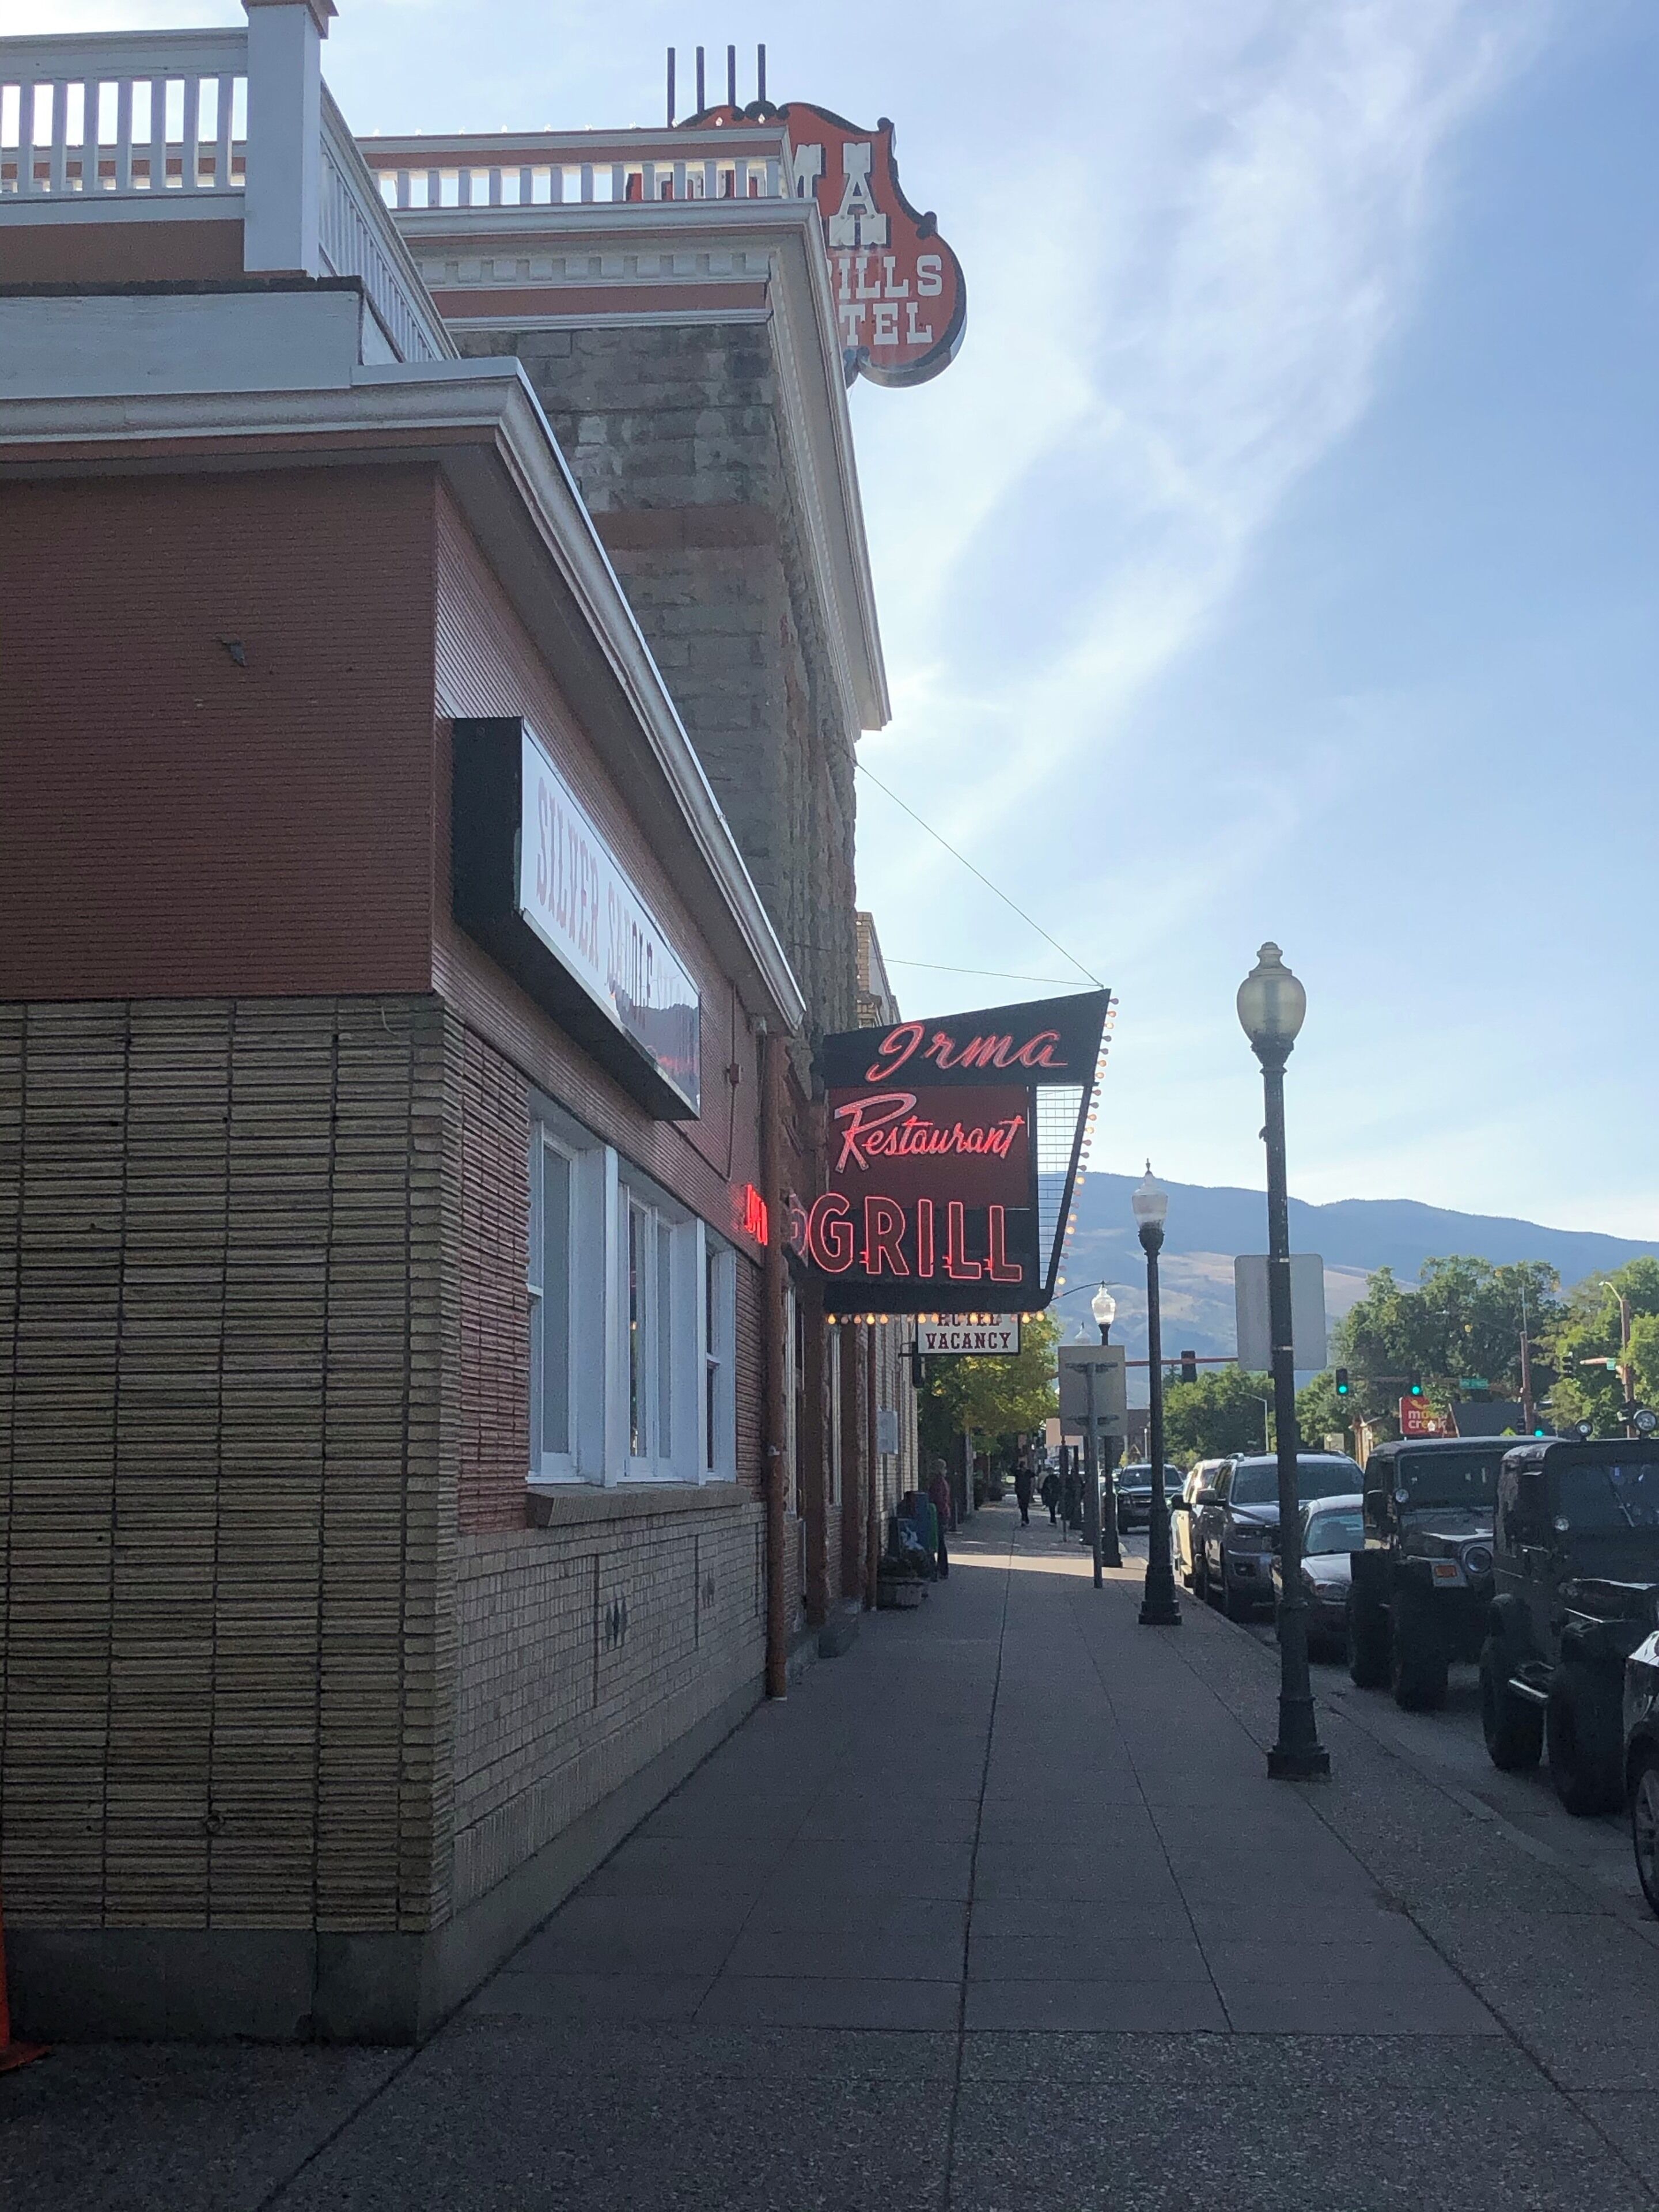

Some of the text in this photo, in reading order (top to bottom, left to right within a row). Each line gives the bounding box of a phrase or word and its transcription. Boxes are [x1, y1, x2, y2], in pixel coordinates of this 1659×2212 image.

[827, 255, 942, 299] ILLS
[839, 302, 933, 346] TEL
[536, 777, 599, 972] SILVER
[865, 1023, 1068, 1082] Irma
[834, 1093, 1025, 1173] Restaurant
[809, 1192, 1022, 1282] GRILL
[926, 1332, 1012, 1349] VACANCY
